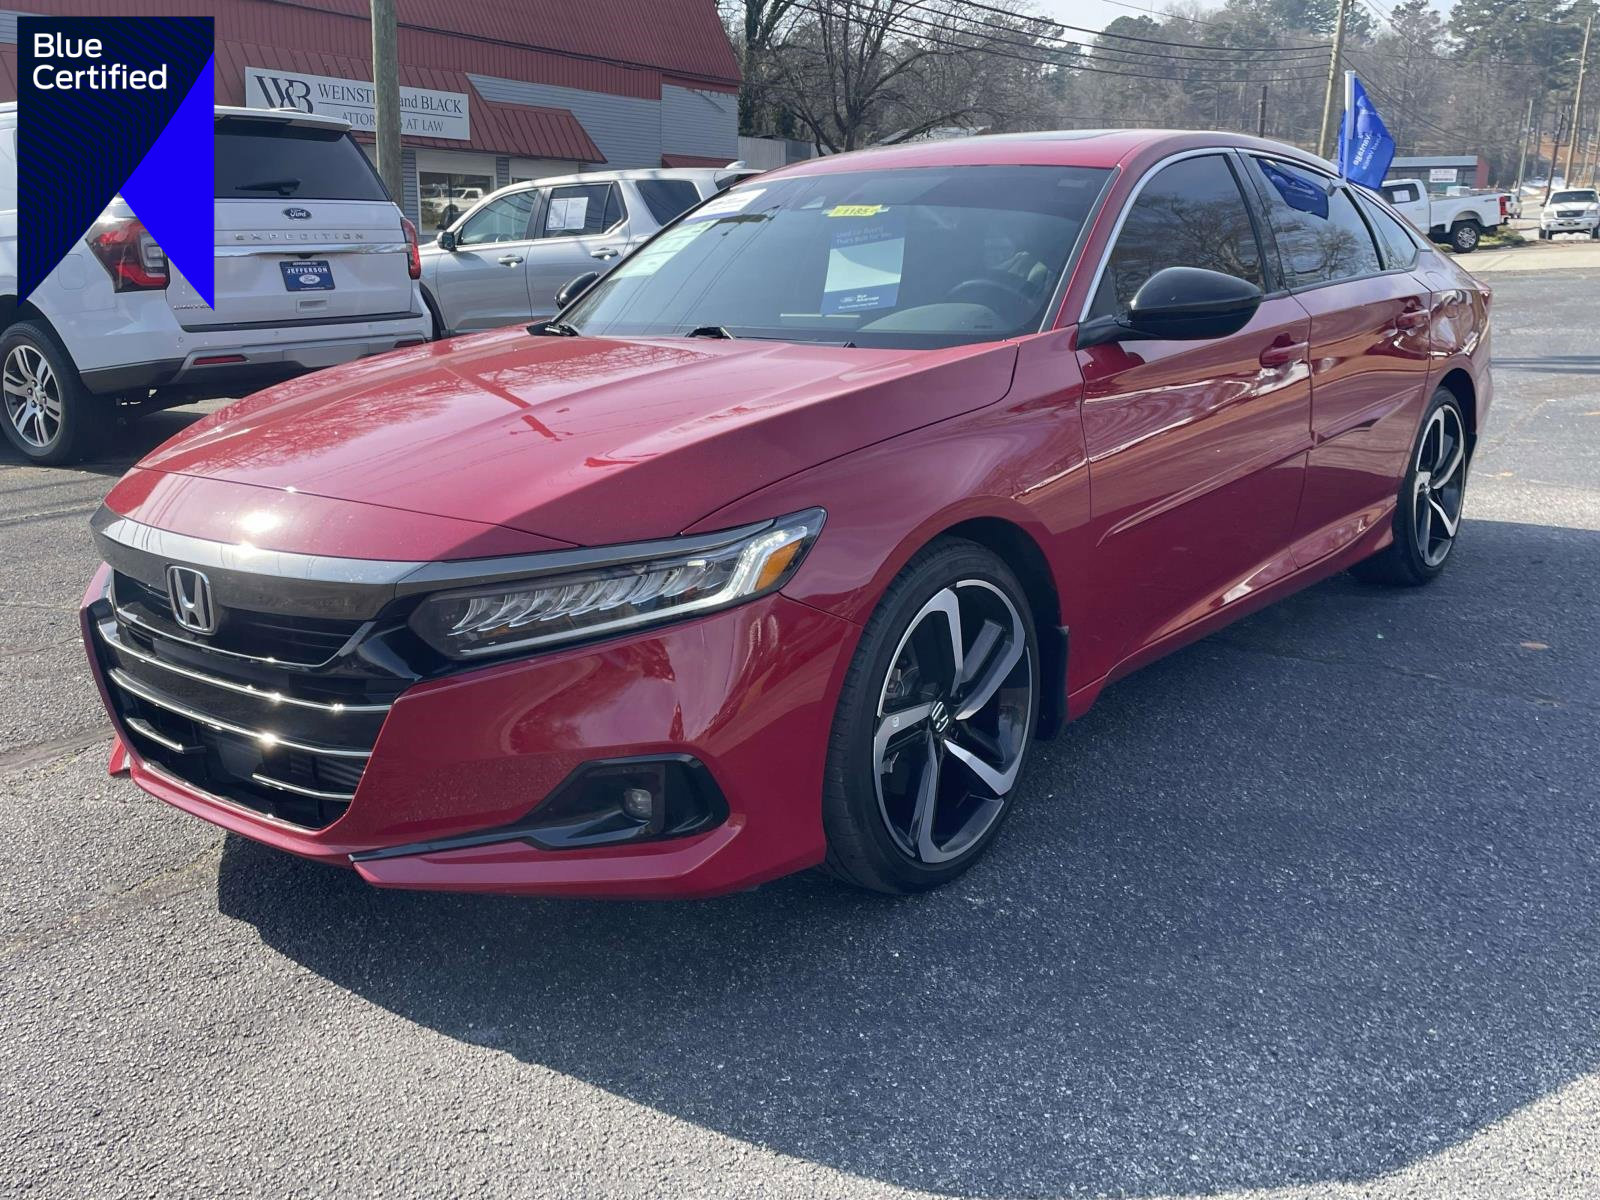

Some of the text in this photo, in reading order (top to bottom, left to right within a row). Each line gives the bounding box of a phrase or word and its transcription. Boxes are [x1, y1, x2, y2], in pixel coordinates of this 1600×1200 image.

[400, 94, 418, 109] and
[421, 95, 463, 113] BLACK
[406, 118, 419, 130] AT
[422, 119, 444, 132] LAW
[234, 232, 365, 241] EXPEDITION
